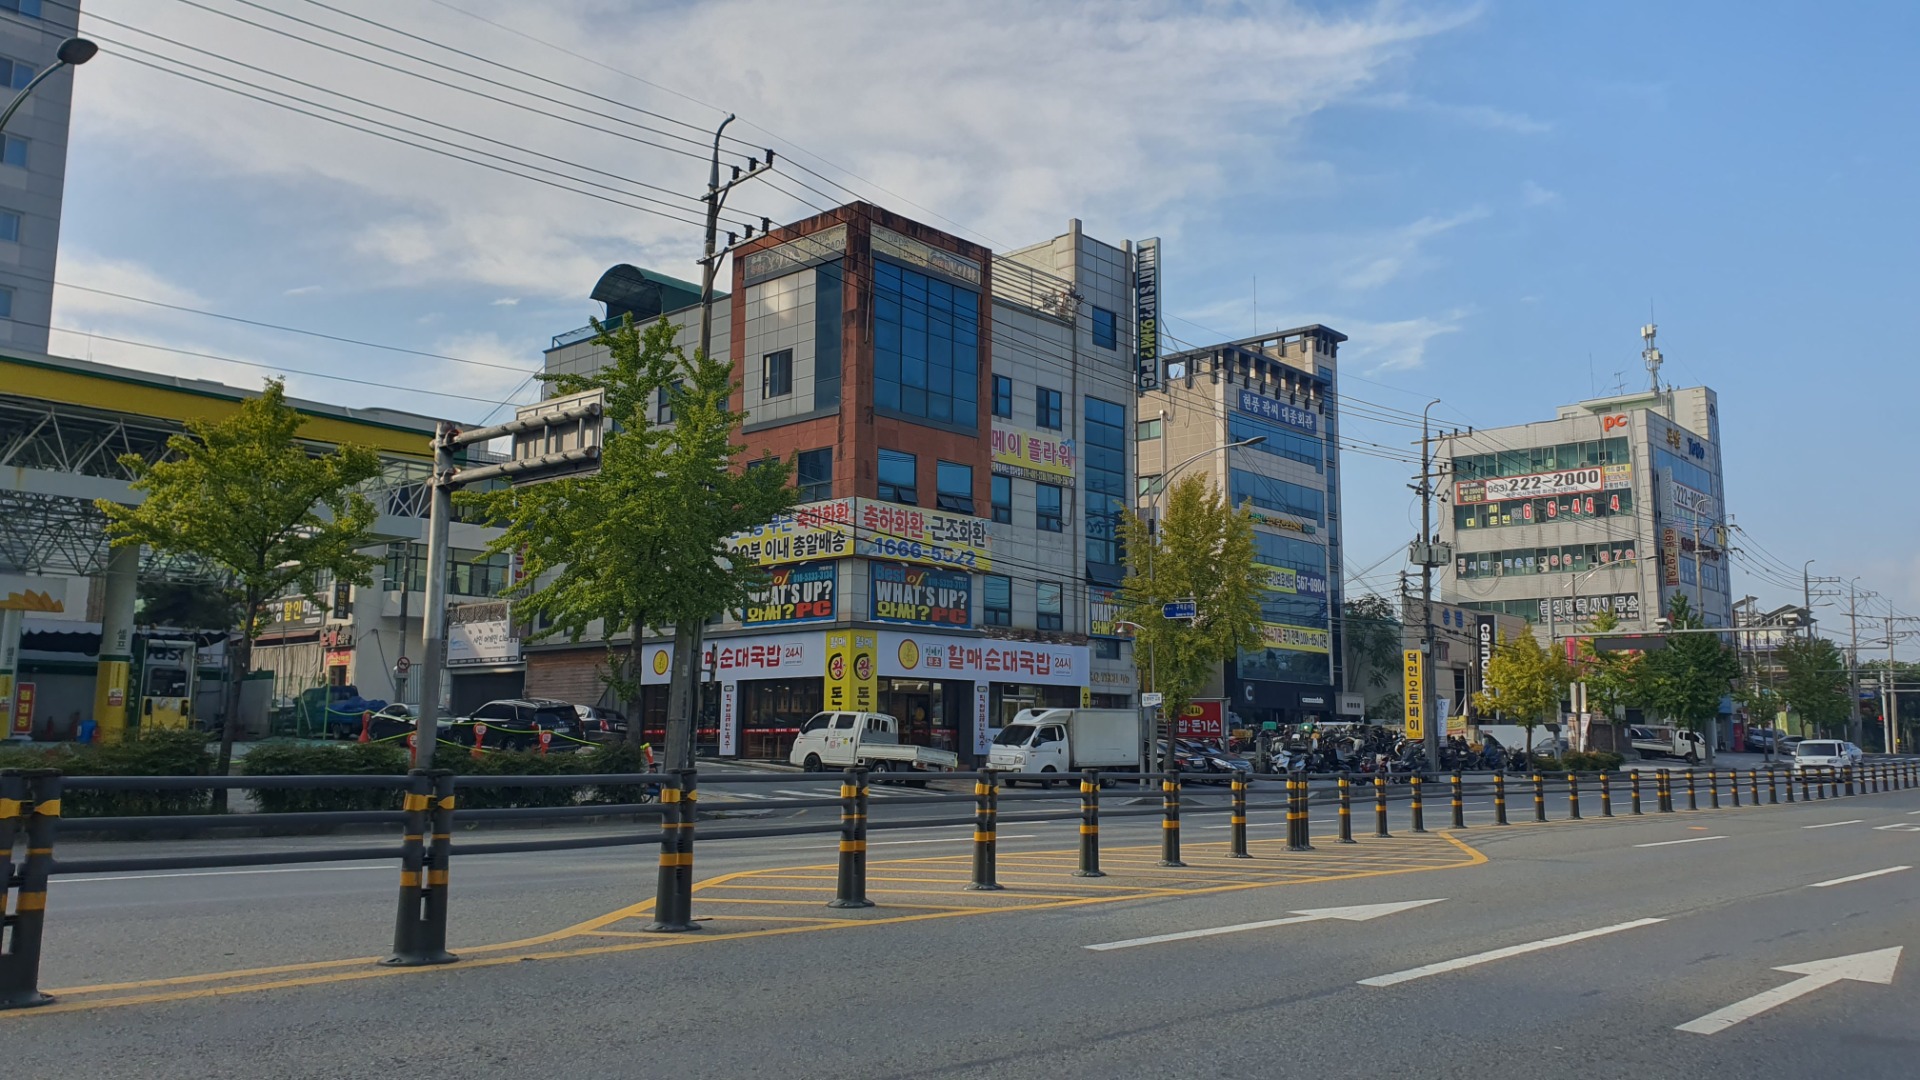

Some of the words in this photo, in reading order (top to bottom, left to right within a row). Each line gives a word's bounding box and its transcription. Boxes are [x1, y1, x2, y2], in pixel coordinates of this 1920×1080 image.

[1138, 248, 1155, 295] WHAT'S
[1139, 296, 1155, 320] UP?
[1140, 359, 1156, 388] PC
[1242, 393, 1260, 412] 현풍
[1262, 400, 1278, 419] 곽씨
[1281, 407, 1313, 430] 대종회관
[992, 429, 1021, 458] 메이
[1027, 437, 1072, 468] 플라워
[797, 502, 850, 529] 축하화환
[765, 536, 790, 560] 이내
[793, 530, 846, 557] 총알배송
[875, 565, 907, 584] Best
[907, 571, 929, 590] of
[1297, 575, 1326, 593] 567-0904
[803, 580, 832, 603] UP?
[876, 580, 935, 607] WHAT'S
[938, 588, 968, 609] UP?
[796, 601, 831, 618] PC
[877, 601, 930, 621] 와써?
[931, 606, 967, 624] PC
[702, 644, 782, 669] 매순대국밥
[785, 646, 803, 659] 24시
[947, 644, 1051, 675] 할매순대국밥
[1055, 657, 1072, 670] 24시
[831, 686, 843, 711] 돈
